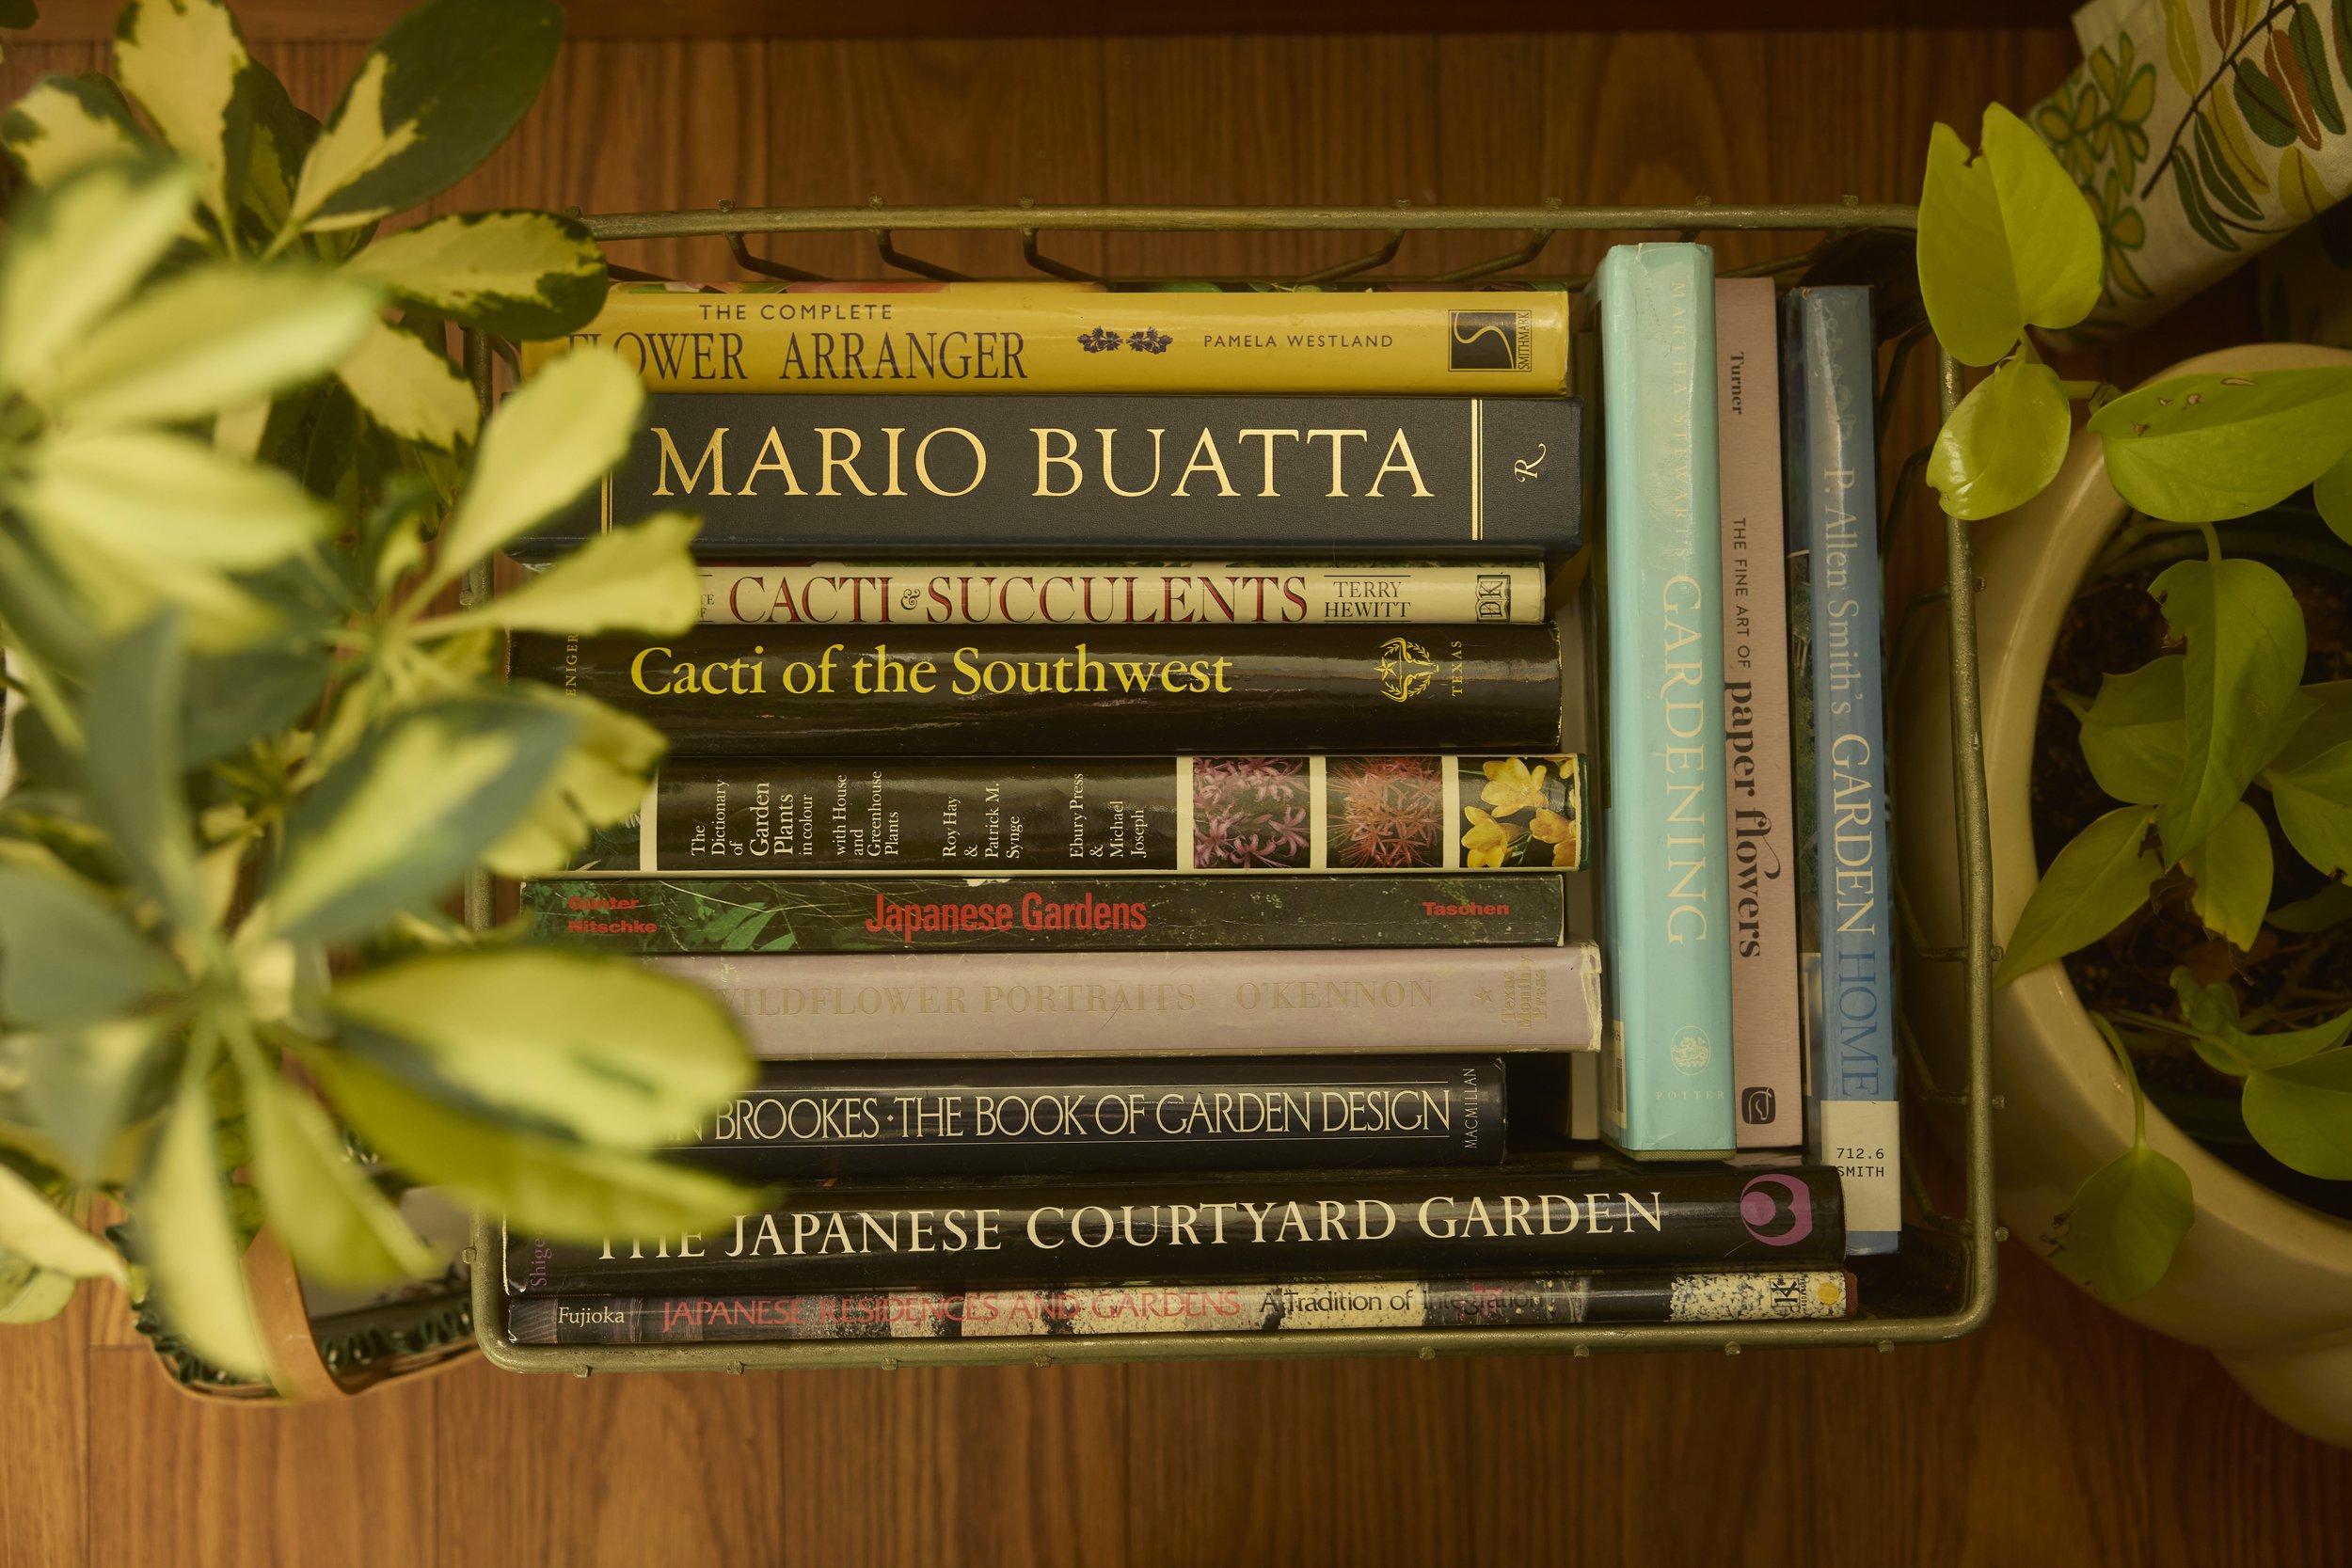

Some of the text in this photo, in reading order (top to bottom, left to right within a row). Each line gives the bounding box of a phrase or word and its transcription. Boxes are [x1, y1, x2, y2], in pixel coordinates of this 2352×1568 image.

[699, 304, 893, 321] THE COMPLETE
[779, 331, 1028, 380] ARRANGER
[1203, 334, 1394, 348] PAMELA WESTLAND
[1518, 311, 1530, 371] SMITHMARK
[1672, 282, 1686, 395] MARTHA
[1731, 351, 1745, 416] Turner
[650, 426, 1435, 498] MARIO BUATTA
[1514, 443, 1547, 483] R
[729, 576, 1308, 624] CACTI & SUCCULENTS
[1325, 601, 1411, 619] HEWITT
[1333, 580, 1403, 599] TERRY
[1479, 580, 1503, 618] DK
[1732, 517, 1751, 669] THE FINE ART OF
[1823, 467, 1864, 716] P. Allen Smith's
[565, 633, 579, 698] ENIGER
[631, 643, 1232, 695] Cacti of the Southwest
[1451, 641, 1463, 697] TEXAS
[1661, 575, 1708, 944] GARDENING
[711, 779, 730, 856] Dictionary
[750, 782, 770, 857] Garden
[773, 794, 794, 856] Plants
[799, 794, 813, 856] in colour
[833, 774, 847, 856] with House
[867, 770, 882, 857] Greenhouse
[884, 812, 899, 856] Plants
[943, 796, 961, 857] Roy Hay
[985, 783, 999, 858] Patrick M.
[1006, 816, 1023, 859] Synge
[1070, 773, 1087, 858] Ebury Press
[1110, 800, 1123, 858] Michael
[1131, 809, 1148, 858] Joseph
[1724, 679, 1781, 958] paper flowers
[1831, 734, 1876, 937] GARDEN
[691, 825, 706, 856] The
[729, 841, 743, 856] of
[850, 829, 864, 856] and
[963, 845, 978, 858] &
[1089, 845, 1104, 858] &
[568, 896, 642, 910] Günter
[568, 920, 657, 933] Nitschke
[866, 891, 1148, 942] Japanese Gardens
[1422, 901, 1510, 917] Taschen
[983, 983, 1195, 1015] PORTRAITS
[1235, 980, 1434, 1011] O'KENNON
[1837, 950, 1880, 1099] HOME
[714, 1096, 880, 1141] BROOKES
[894, 1095, 964, 1139] THE
[976, 1094, 1088, 1137] BOOK
[1095, 1094, 1152, 1135] OF
[1156, 1091, 1311, 1134] GARDEN
[1322, 1088, 1451, 1132] DESIGN
[1464, 1068, 1476, 1149] MACMILLAN
[1655, 1089, 1725, 1100] POTTER
[1836, 1148, 1885, 1160] 712.6
[1836, 1165, 1885, 1178] SMITH
[724, 1208, 1003, 1259] JAPANESE
[1027, 1198, 1396, 1251] COURTYARD
[1418, 1191, 1662, 1240] GARDEN
[529, 1231, 552, 1287] Shige
[558, 1306, 626, 1328] Fujioka
[662, 1290, 1242, 1334] JAPANESE RESIDENCES AND GARDENS
[1260, 1288, 1544, 1316] A Tradition of Integration
